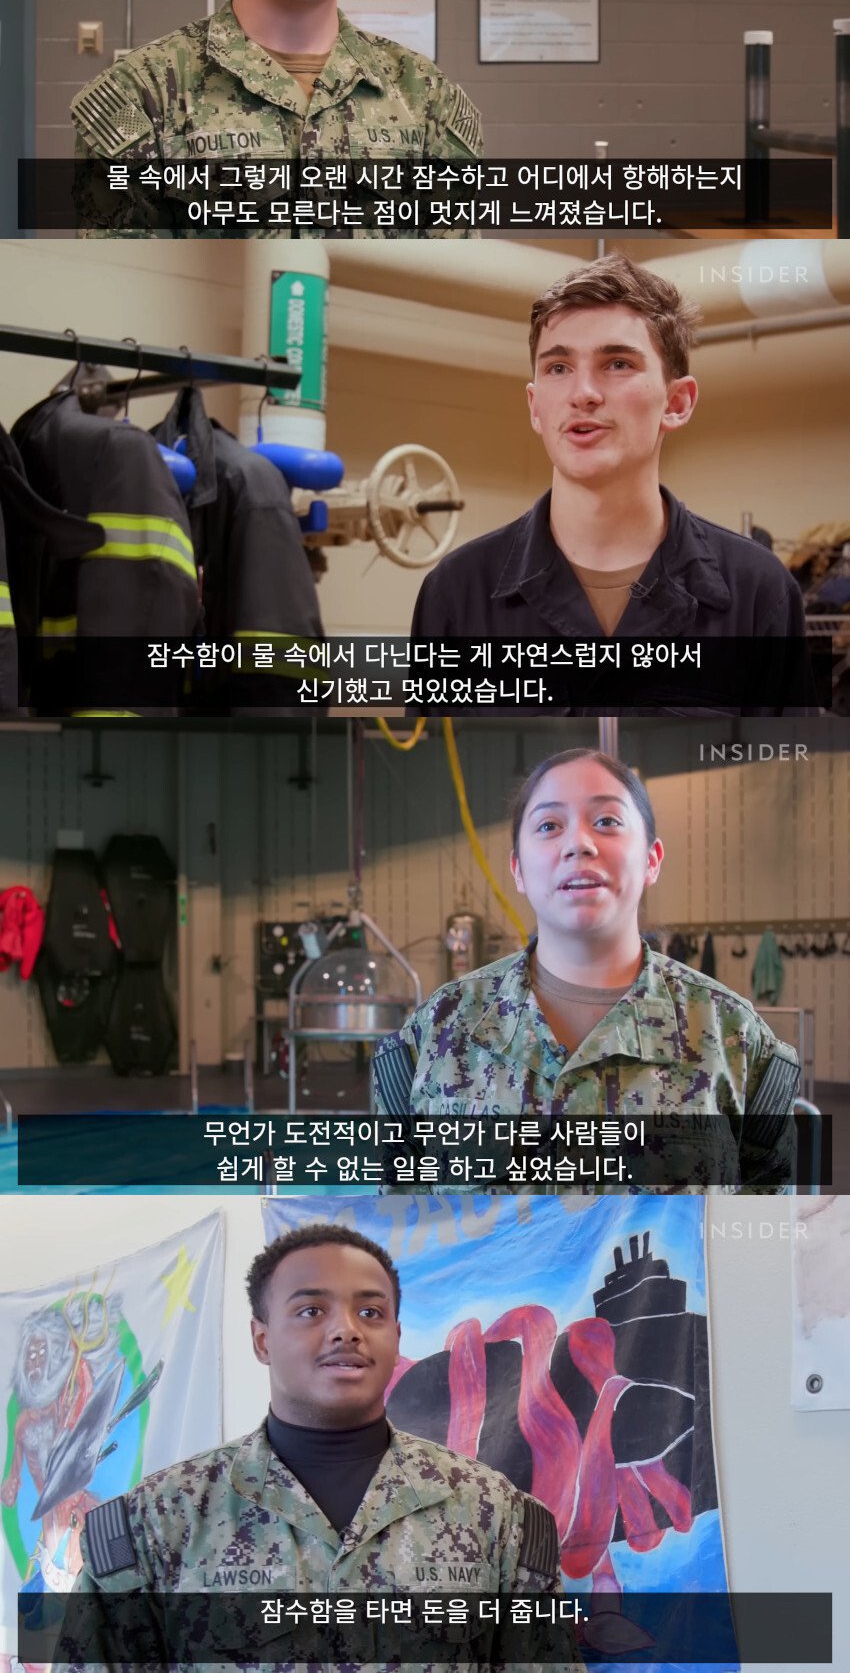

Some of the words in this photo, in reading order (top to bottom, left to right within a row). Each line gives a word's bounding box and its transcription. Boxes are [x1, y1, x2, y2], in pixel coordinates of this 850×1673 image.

[186, 131, 262, 156] MOULTON
[367, 128, 395, 143] U.S.
[399, 129, 424, 145] NAV
[439, 1103, 501, 1121] CASILLAS
[202, 1569, 273, 1587] LAWSON
[415, 1566, 442, 1582] U.S.
[448, 1566, 481, 1583] NAVY
